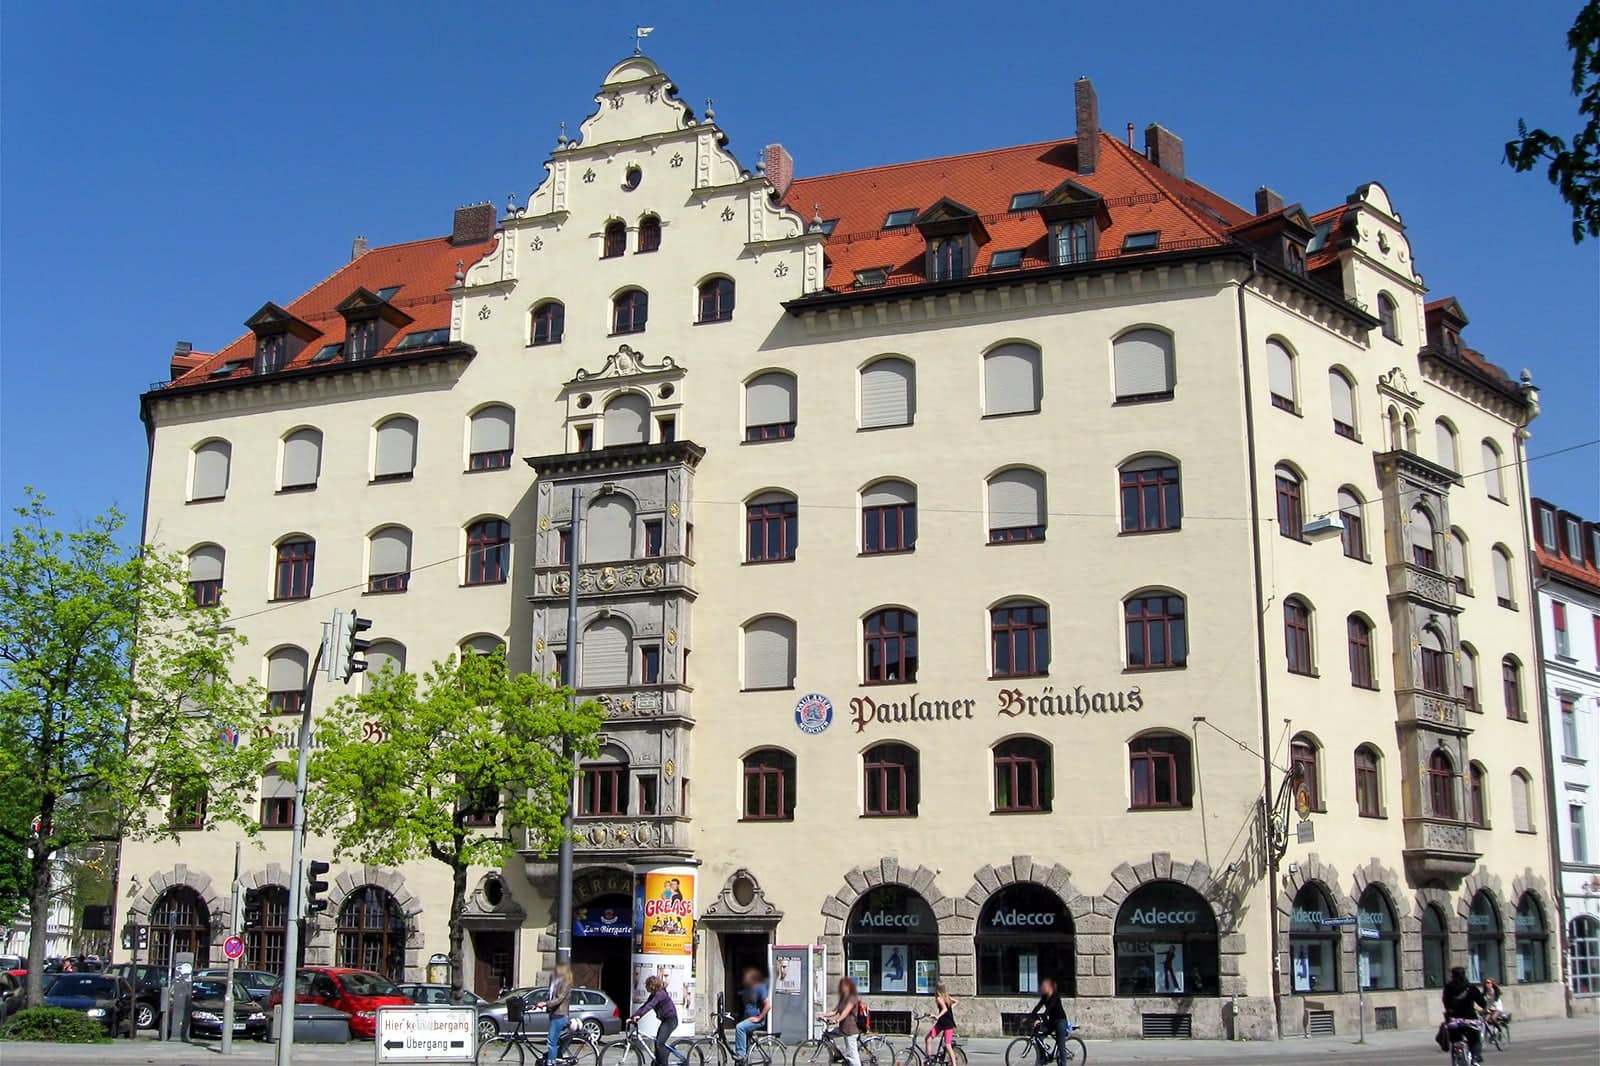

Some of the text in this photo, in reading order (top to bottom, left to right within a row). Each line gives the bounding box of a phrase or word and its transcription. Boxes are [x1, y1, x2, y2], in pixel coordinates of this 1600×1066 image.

[796, 694, 832, 712] PAULANER
[849, 685, 1144, 734] Paulaner Bräuhaus
[645, 899, 694, 918] GREASE
[991, 908, 1056, 926] Adecco
[1130, 906, 1198, 924] Adecco
[1358, 908, 1385, 924] decco
[860, 910, 921, 927] Adecco
[600, 924, 632, 936] Biergarte
[385, 1019, 404, 1031] Hier
[428, 1019, 469, 1033] bergang
[406, 1036, 448, 1052] Übergang
